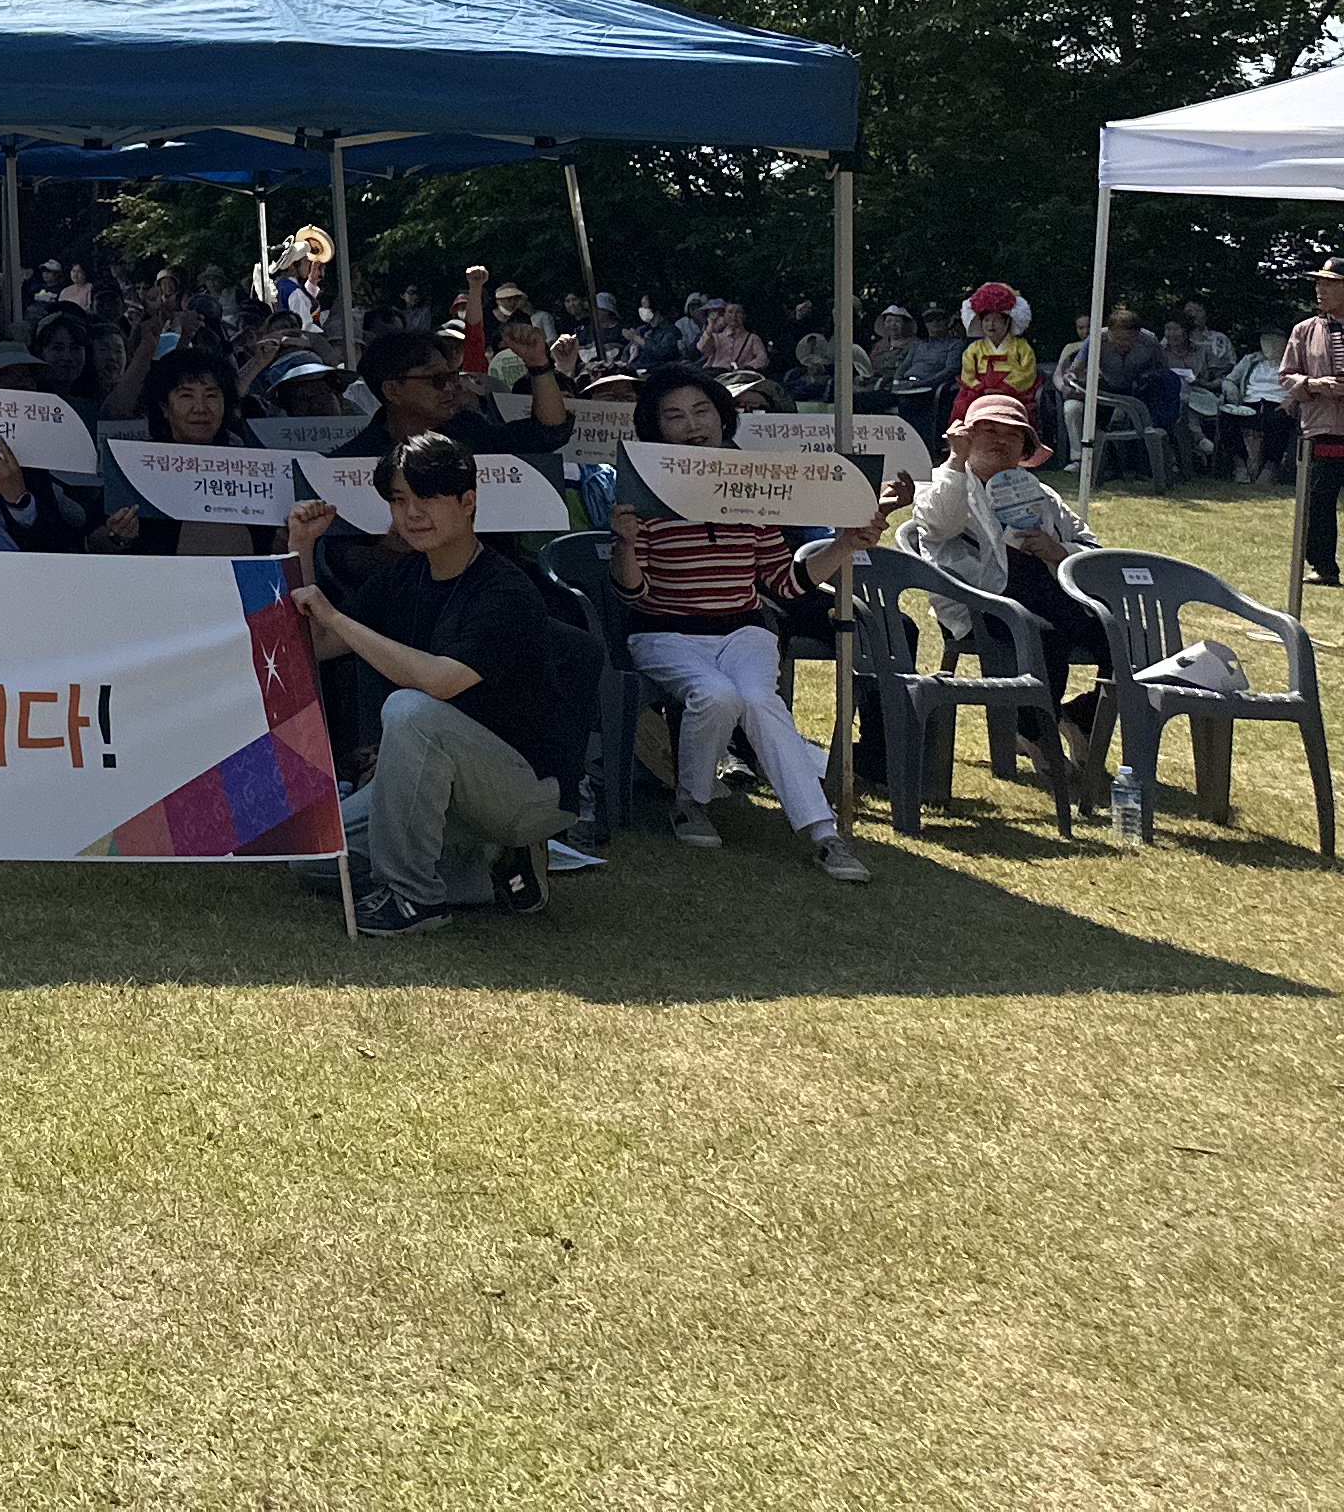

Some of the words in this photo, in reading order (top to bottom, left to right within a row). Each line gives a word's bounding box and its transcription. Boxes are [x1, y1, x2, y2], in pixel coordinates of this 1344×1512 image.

[24, 404, 64, 423] 건립을
[749, 424, 870, 441] 국립강화고려관
[141, 454, 275, 478] 국립강화고려박물관
[477, 466, 523, 484] 건립을
[660, 456, 799, 481] 국립강화고려박물관
[803, 464, 847, 481] 건립을
[193, 478, 274, 499] 기원합니다!
[714, 482, 792, 501] 기원합니다!
